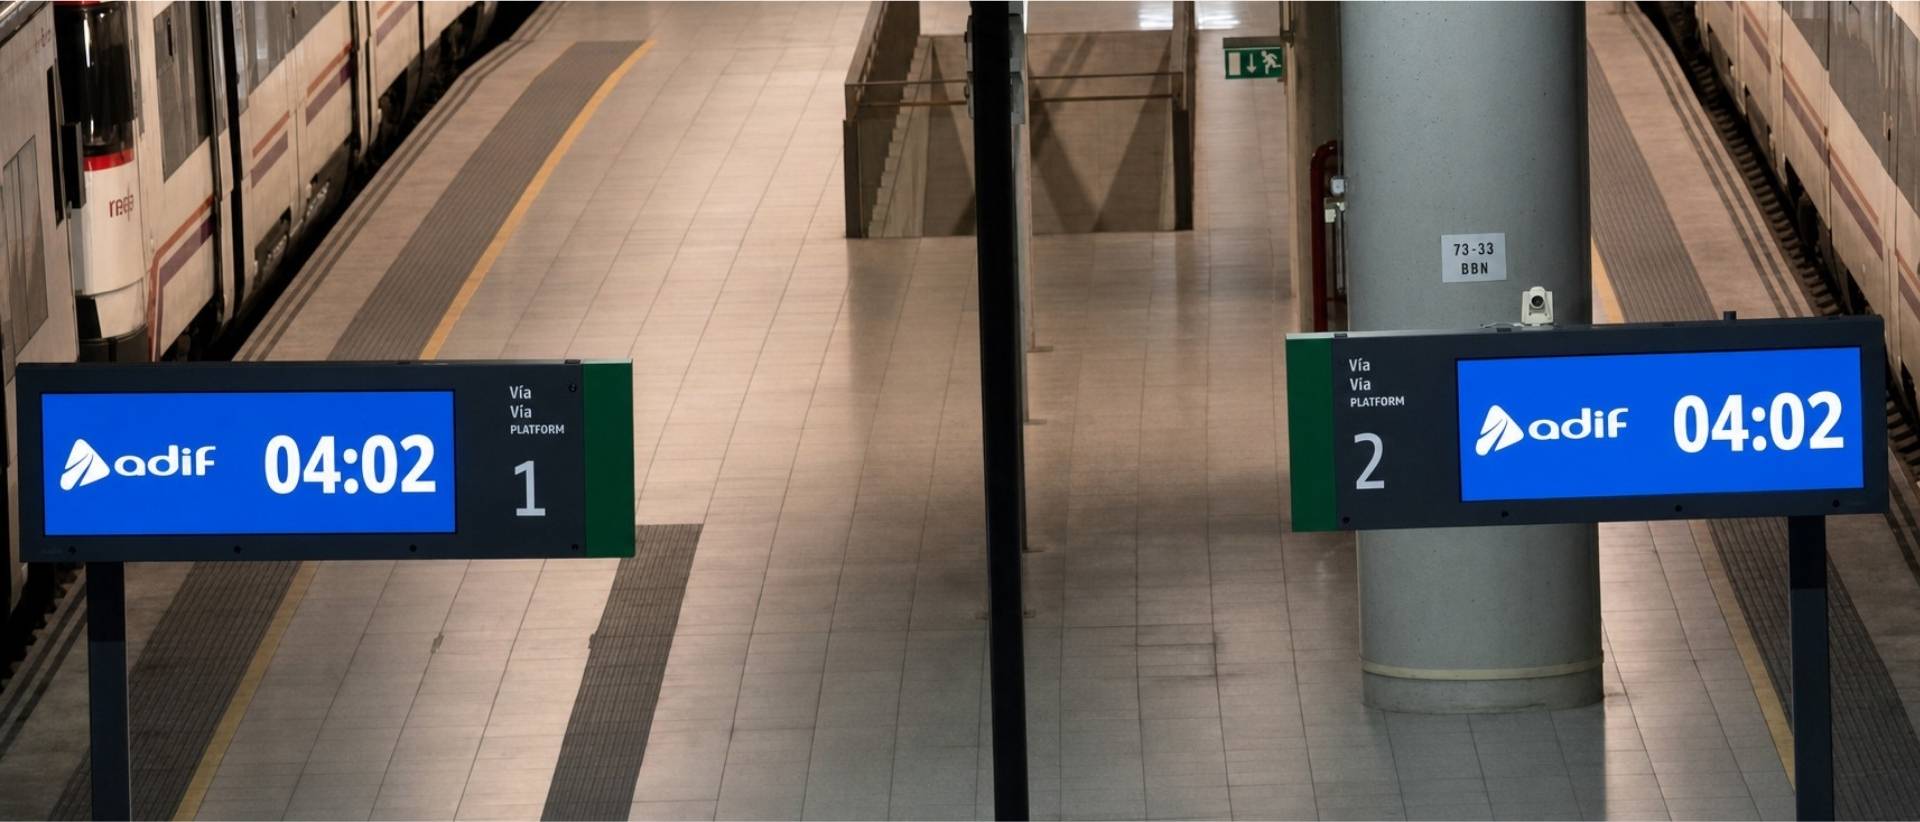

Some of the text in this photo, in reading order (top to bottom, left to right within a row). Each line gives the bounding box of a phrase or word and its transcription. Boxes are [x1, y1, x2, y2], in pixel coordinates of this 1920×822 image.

[1453, 242, 1494, 256] 73-33
[1461, 262, 1488, 275] BBN
[1349, 357, 1371, 372] Vía
[509, 384, 532, 399] Vía
[1350, 396, 1405, 408] PLATFORM
[510, 424, 565, 435] PLATFORM
[1529, 390, 1844, 454] adif 04:02
[114, 434, 436, 495] adif 04:02
[1354, 432, 1385, 490] 2
[513, 459, 546, 518] 1
